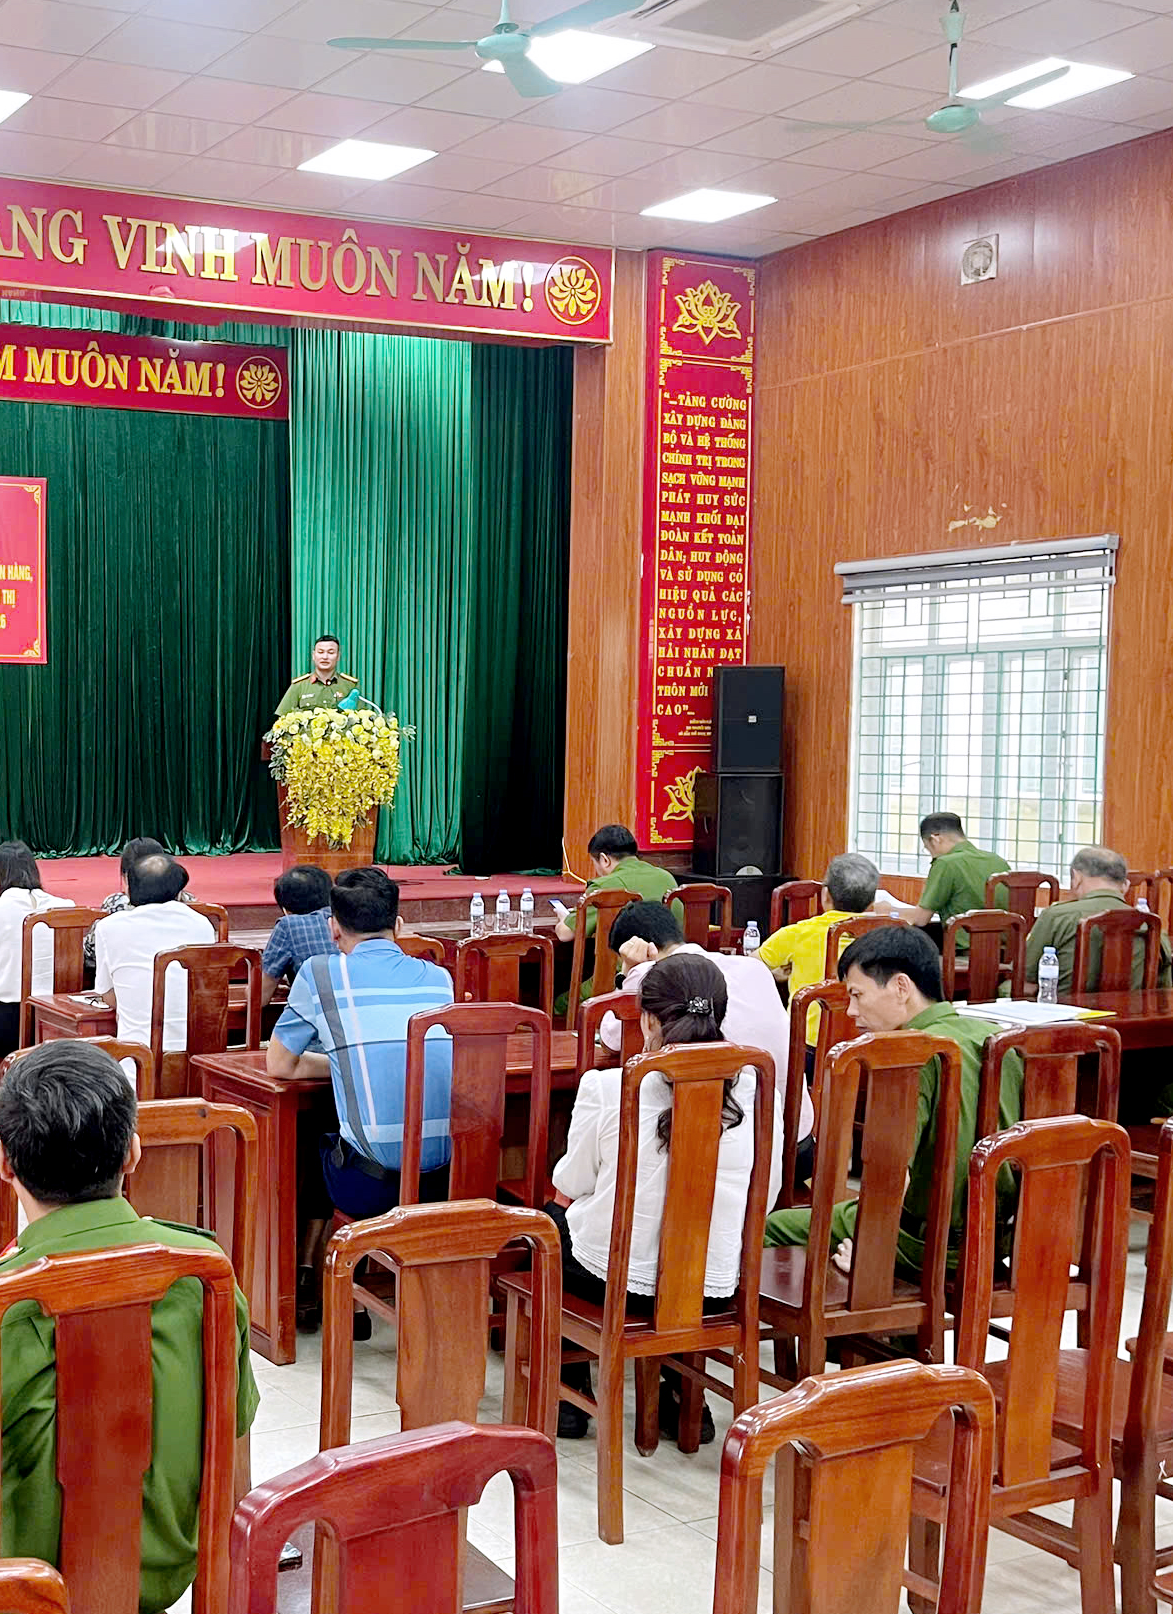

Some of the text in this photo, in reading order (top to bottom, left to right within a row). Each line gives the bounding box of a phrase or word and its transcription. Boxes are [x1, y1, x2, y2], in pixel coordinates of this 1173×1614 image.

[102, 214, 239, 282] VINH
[251, 227, 402, 299] MUÔN
[412, 243, 534, 312] NĂM!
[24, 341, 131, 388] MUÔN
[137, 347, 225, 398] NĂM!
[711, 393, 747, 411] CƯỜNG
[663, 410, 746, 430] XÂY DỰNG ĐẢNG
[663, 429, 746, 450] BỘ VÀ HỆ THỐNG
[662, 449, 746, 470] CHÍNH TRỊ TRONG
[661, 471, 746, 490] SẠCH VỮNG MẠNH
[661, 489, 746, 507] PHÁT HUY SỨC
[661, 509, 745, 529] MẠNH KHỐI ĐẠI
[660, 527, 744, 545] ĐOÀN KẾT TOÀN
[690, 551, 712, 563] HUY
[715, 549, 744, 567] ĐỘNG
[660, 565, 743, 585] VÀ SỬ DỤNG CÓ
[2, 589, 15, 608] THỊ
[659, 585, 743, 604] HIỆU QUẢ CÁC
[658, 602, 705, 621] NGUỒN
[658, 624, 742, 642] XÂY DỰNG XÃ
[658, 642, 742, 661] HẢI NHÂN ĐẠT
[658, 660, 701, 678] CHUẨN
[657, 682, 708, 697] THÔN MỚI
